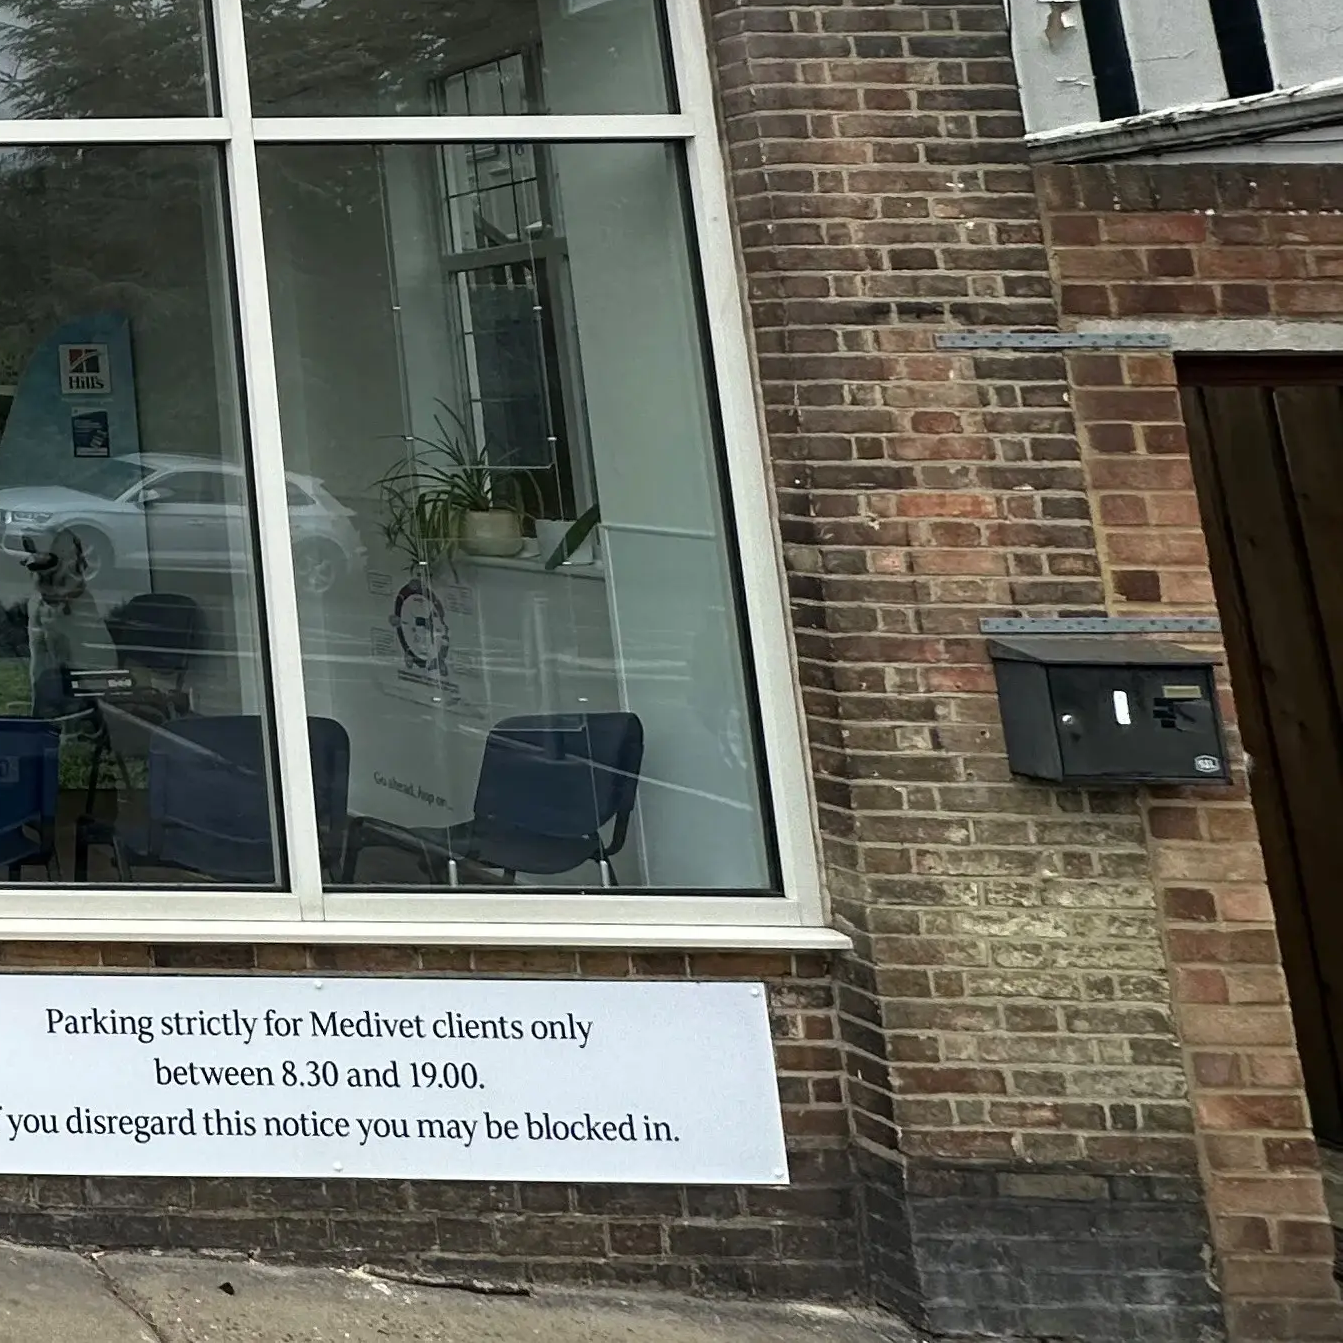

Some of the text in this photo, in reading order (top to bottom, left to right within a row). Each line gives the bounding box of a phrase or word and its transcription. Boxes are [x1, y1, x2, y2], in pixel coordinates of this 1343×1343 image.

[46, 1008, 592, 1048] Parking strictly for Medivet clients only
[154, 1058, 484, 1089] between 8.30 and 19.00.
[6, 1114, 59, 1141] you
[66, 1107, 196, 1143] disregard
[203, 1109, 256, 1136] this
[264, 1111, 349, 1137] notice
[356, 1119, 411, 1145] you
[417, 1120, 477, 1147] may
[483, 1112, 518, 1139] be
[525, 1113, 637, 1141] blocked
[644, 1115, 679, 1141] in.
